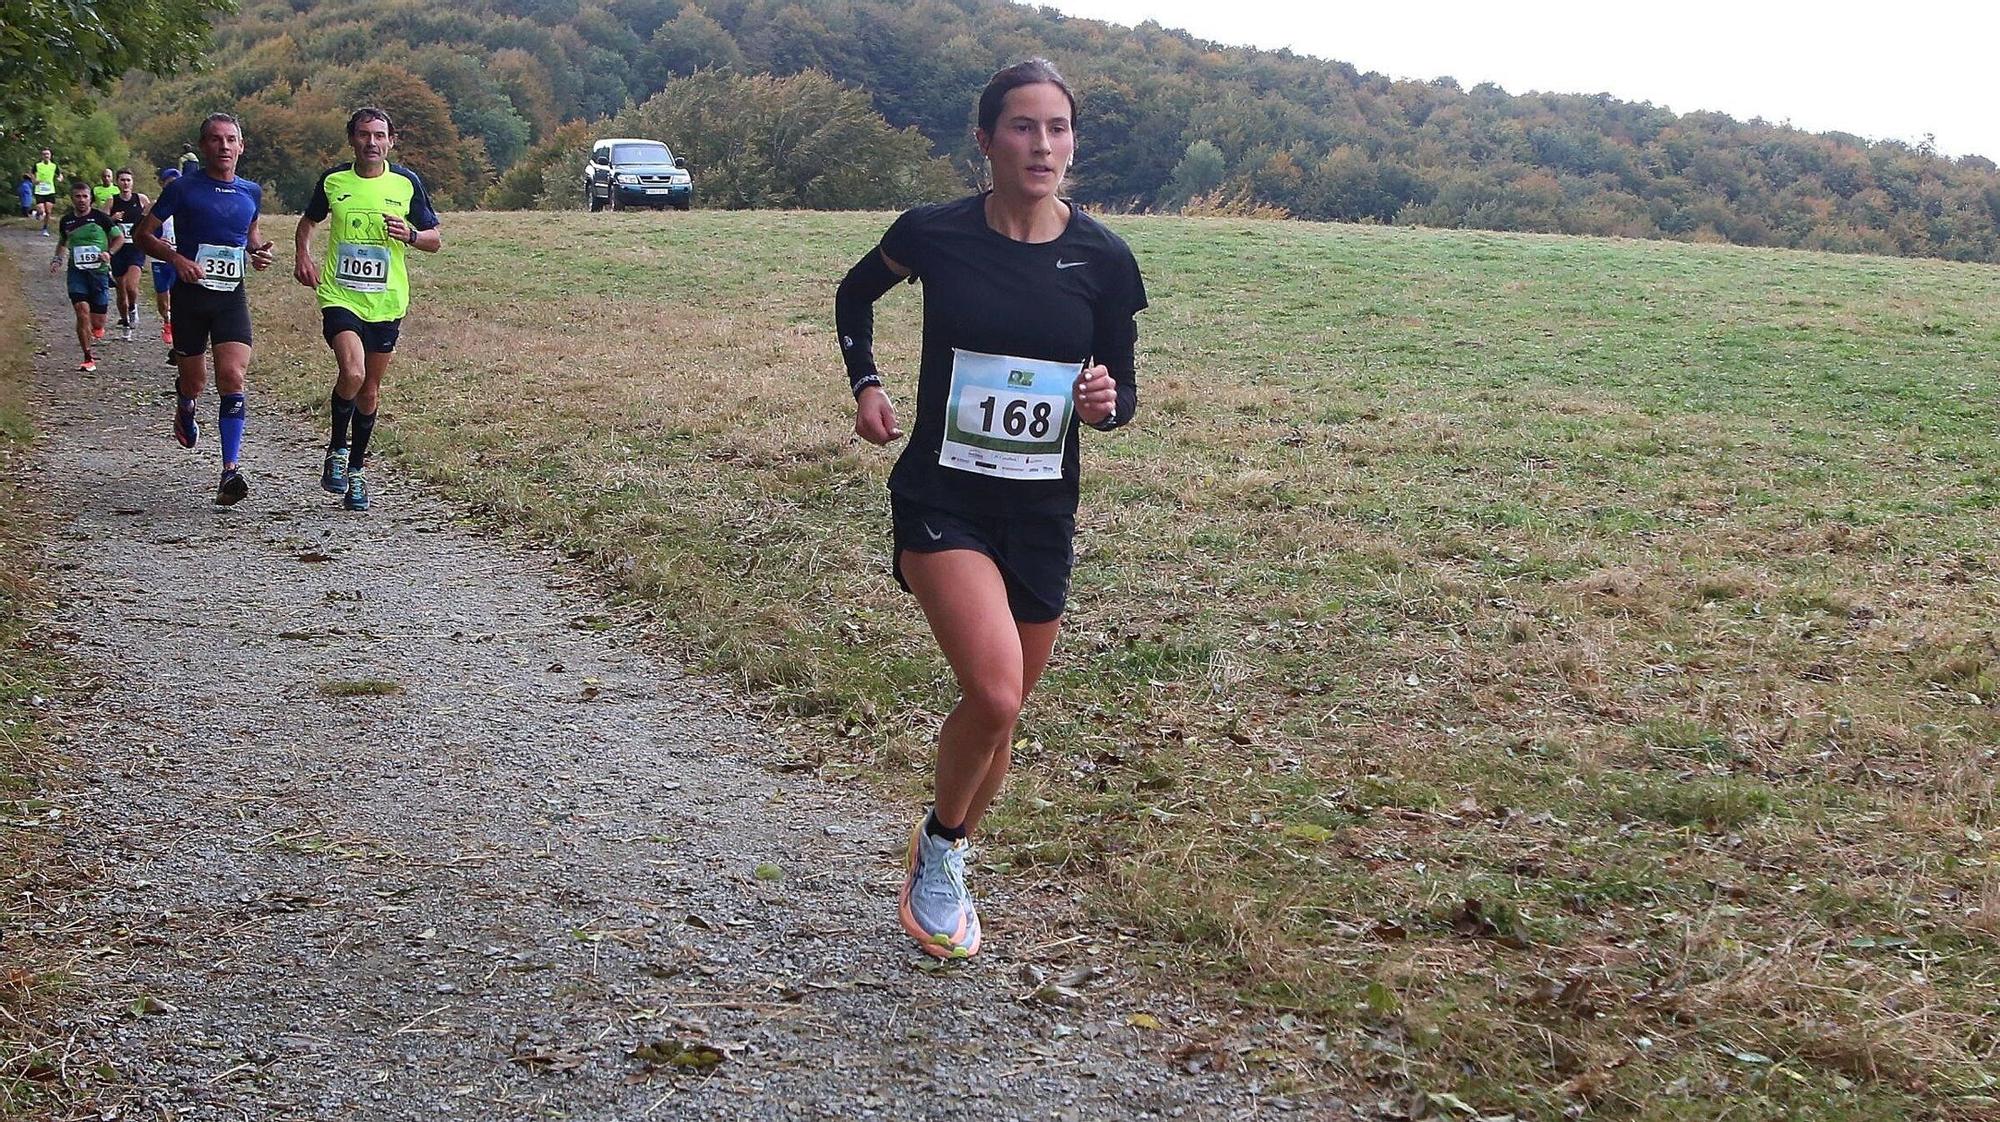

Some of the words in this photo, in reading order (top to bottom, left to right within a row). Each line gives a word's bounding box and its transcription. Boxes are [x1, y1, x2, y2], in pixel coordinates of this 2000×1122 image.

[80, 253, 96, 261] 169
[205, 259, 235, 277] 330
[343, 258, 382, 276] 1061
[979, 396, 1052, 439] 168
